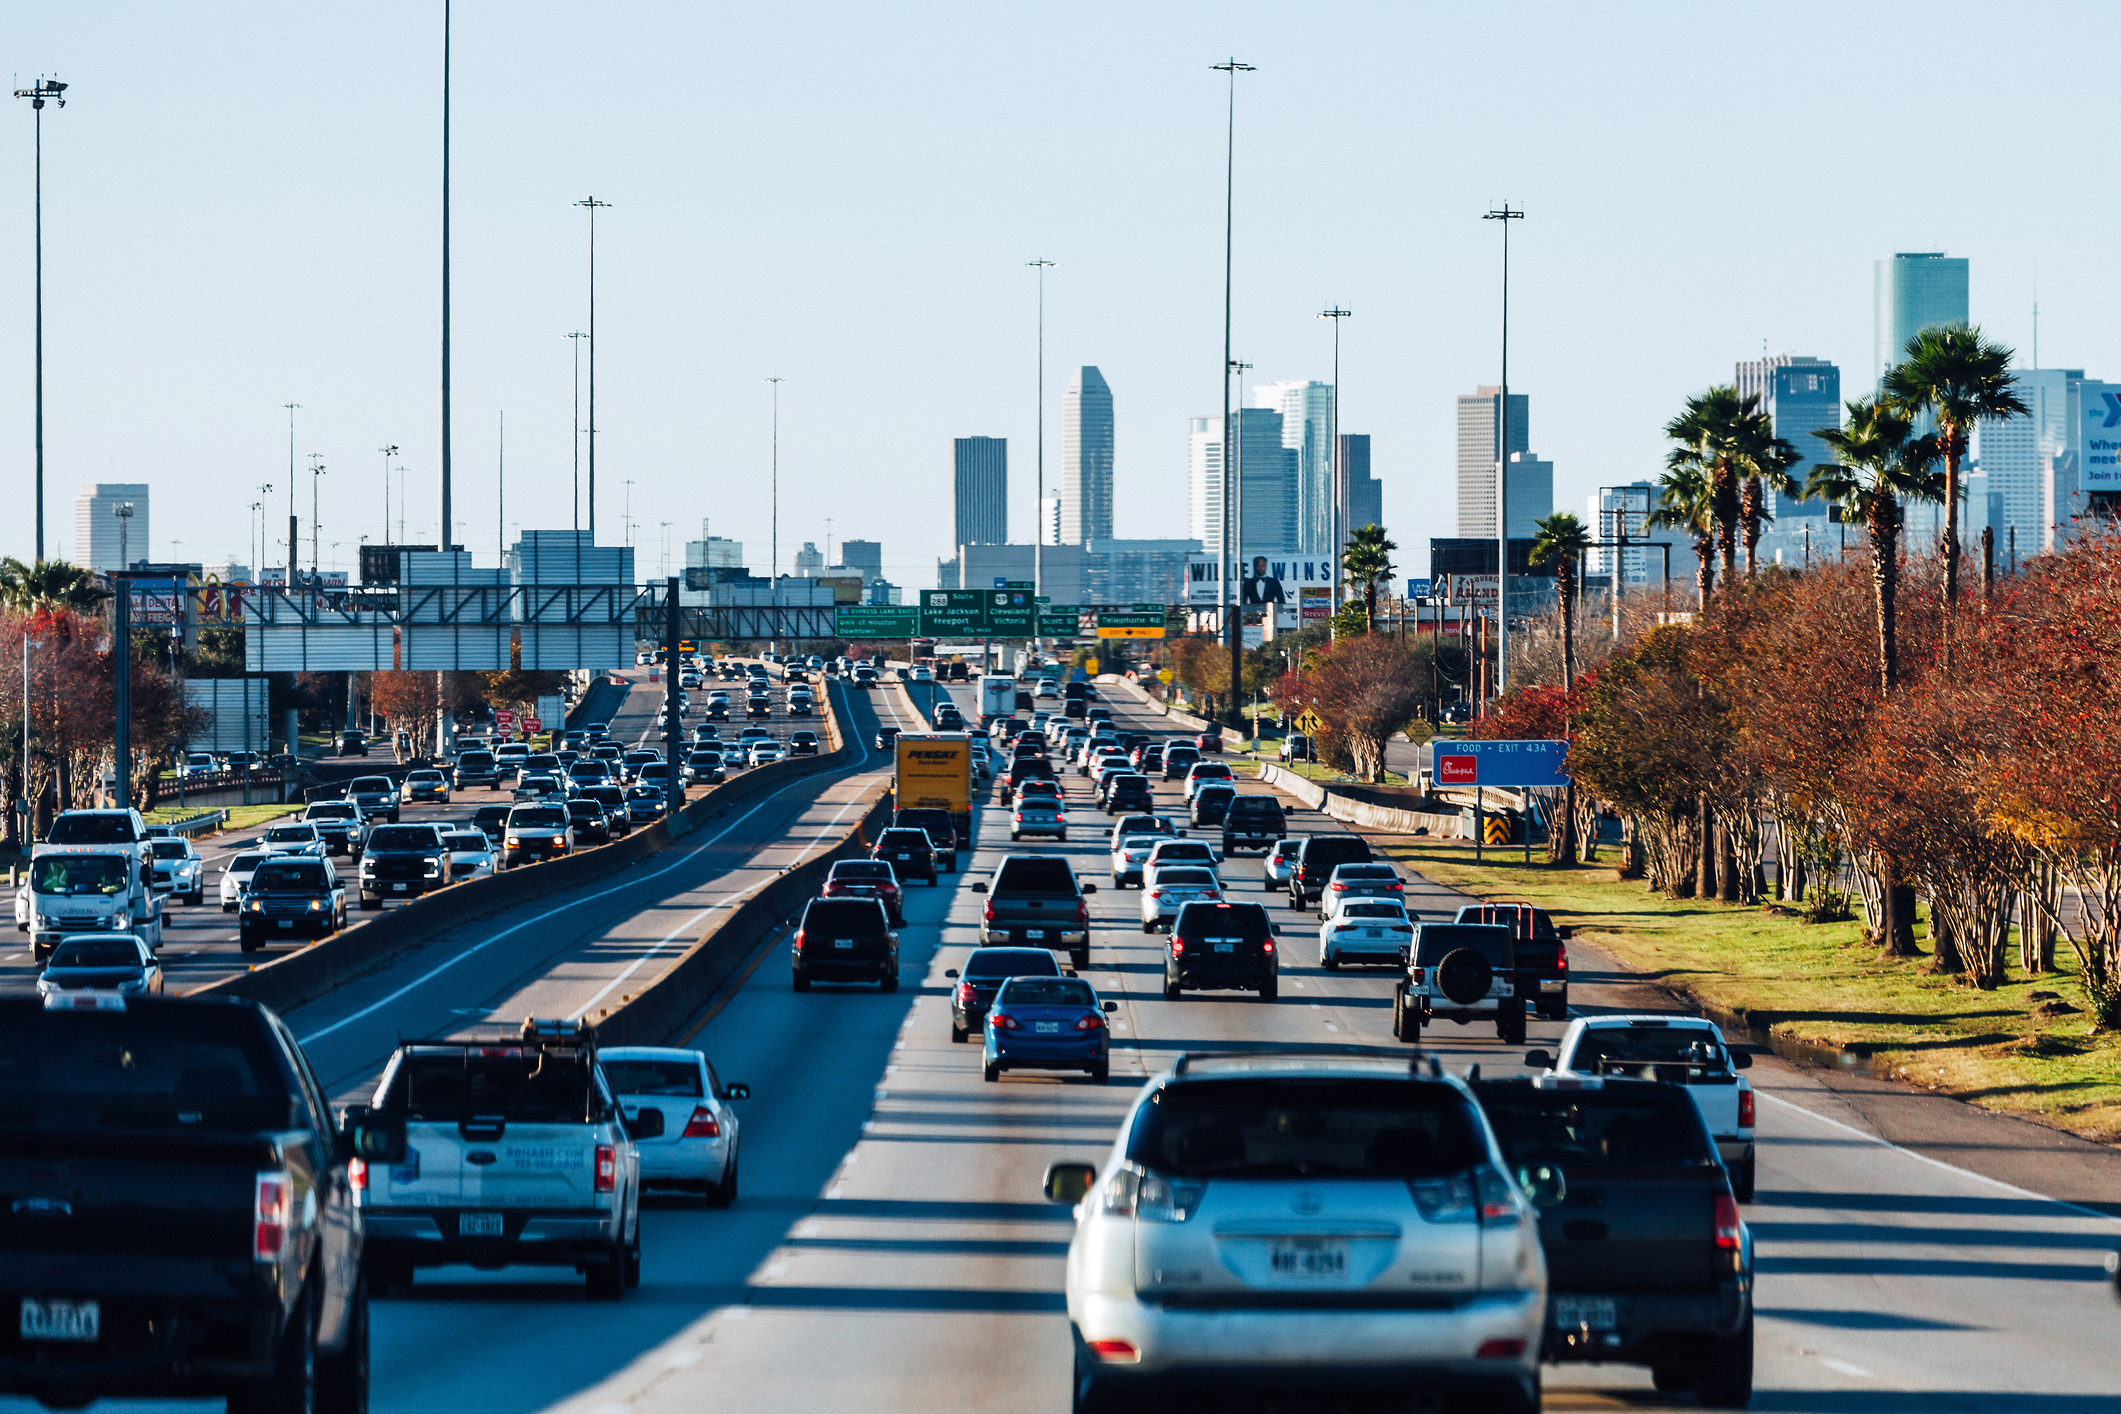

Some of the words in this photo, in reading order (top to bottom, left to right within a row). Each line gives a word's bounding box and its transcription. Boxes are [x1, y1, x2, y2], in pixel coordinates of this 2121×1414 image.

[2089, 440, 2121, 450] Whe
[2089, 471, 2111, 480] Join
[1272, 562, 1331, 581] WINS
[931, 598, 947, 606] 288
[933, 618, 969, 626] Freeport
[994, 617, 1026, 625] Victoria
[1101, 616, 1148, 625] Telephone
[1456, 743, 1482, 753] FOOD
[1498, 743, 1520, 753] EXIT
[1526, 743, 1547, 753] 43A
[908, 751, 960, 759] PENSKE
